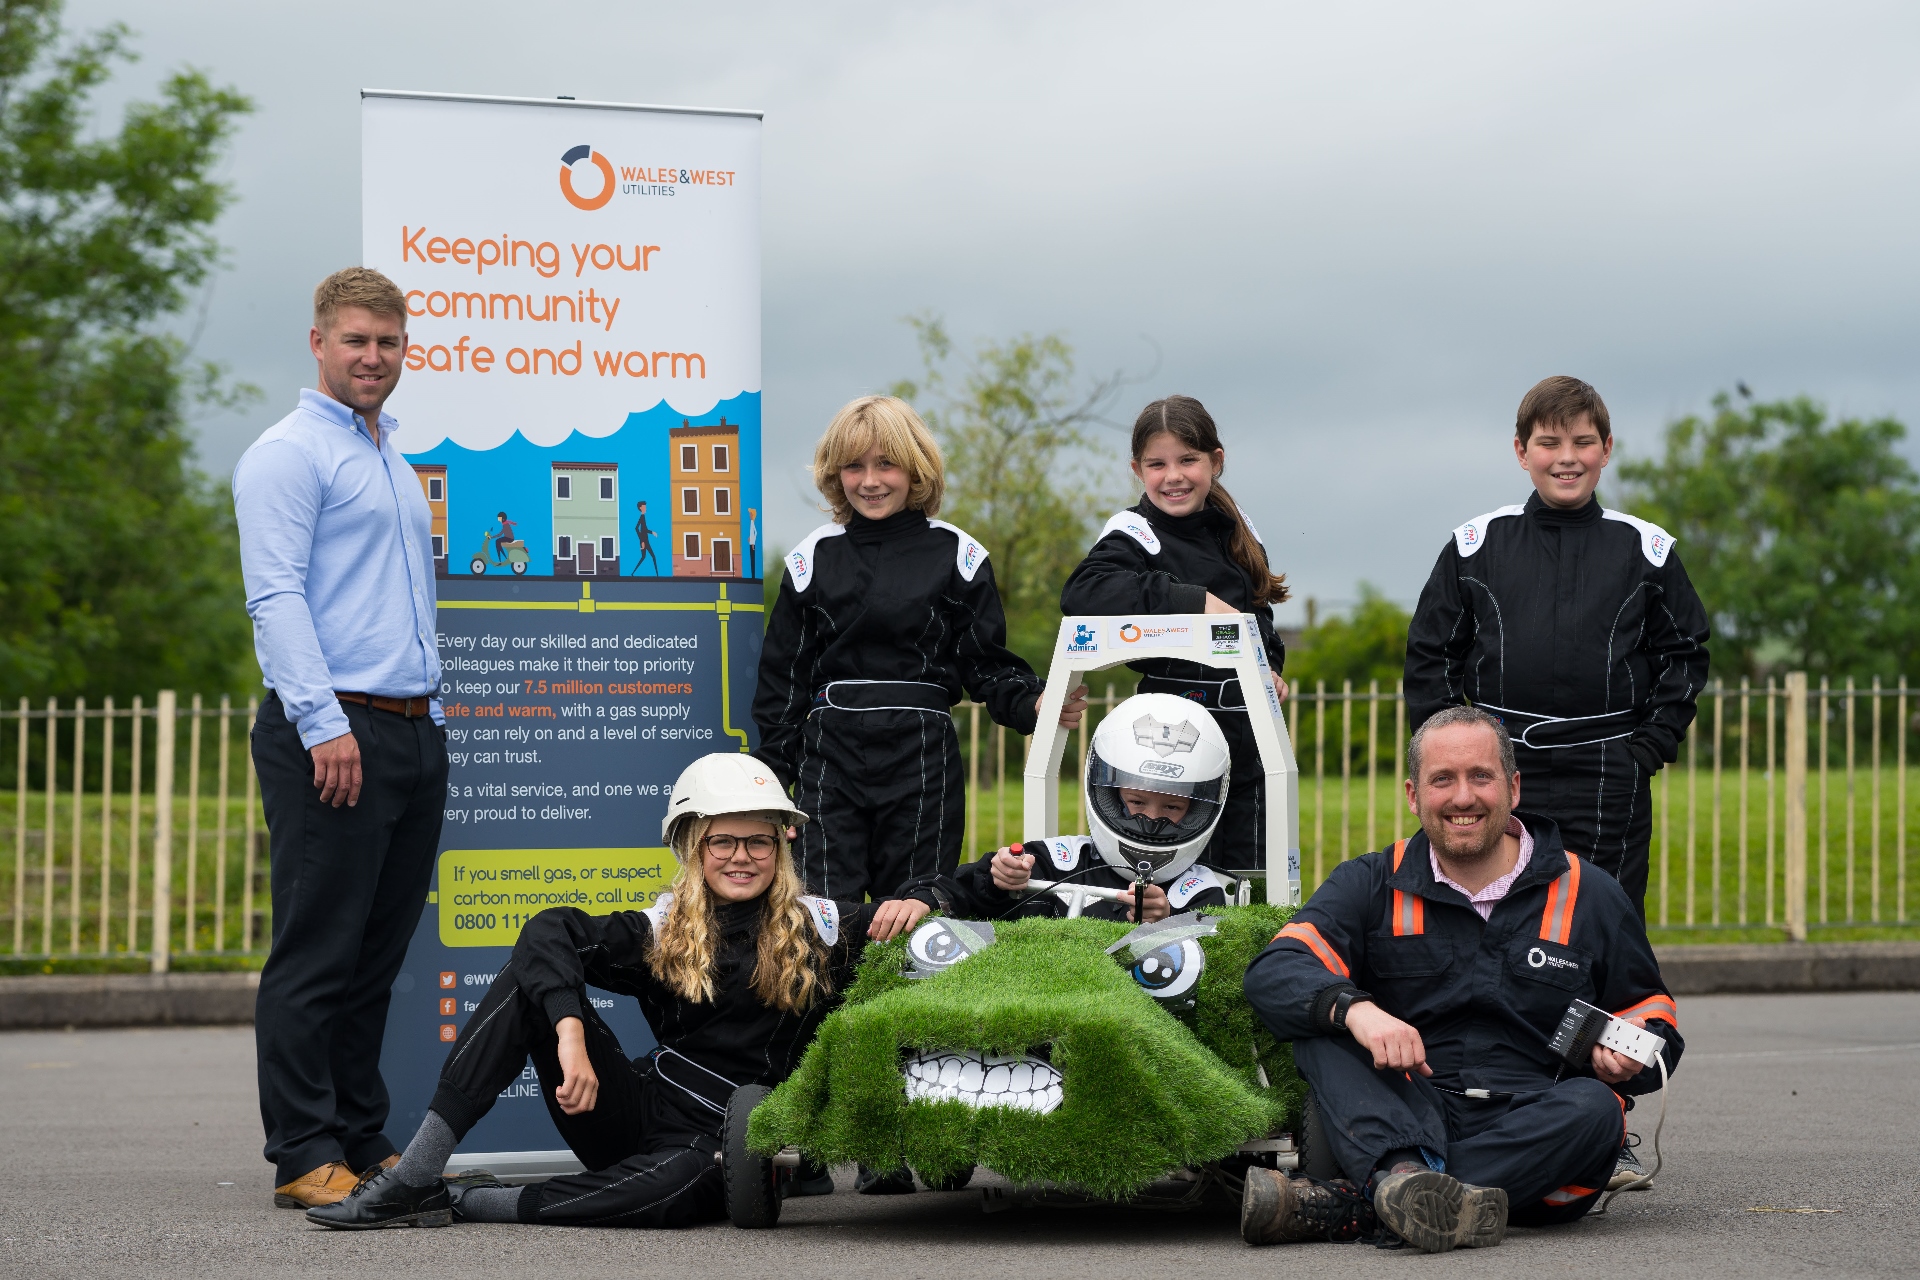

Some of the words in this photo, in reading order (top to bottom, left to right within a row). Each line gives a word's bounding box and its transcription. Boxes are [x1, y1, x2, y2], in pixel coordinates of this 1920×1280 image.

[621, 167, 735, 187] WALES&WEST
[622, 184, 675, 197] UTILITIES
[403, 226, 560, 278] Keeping
[571, 243, 660, 277] your
[405, 288, 620, 333] community
[405, 335, 495, 373] safe
[506, 340, 582, 376] and
[594, 351, 705, 379] warm
[436, 633, 476, 651] Every
[481, 634, 507, 651] day
[512, 637, 536, 648] our
[541, 634, 586, 648] skilled
[592, 635, 618, 648] and
[624, 635, 697, 648] dedicated
[1066, 643, 1098, 652] Admiral
[440, 657, 514, 675] colleagues
[520, 657, 559, 671] make
[564, 657, 572, 671] it
[577, 658, 609, 671] their
[614, 659, 638, 674] top
[644, 658, 694, 674] priority
[441, 683, 451, 694] o
[456, 680, 491, 697] keep
[496, 683, 520, 694] our
[525, 680, 547, 694] 7.5
[552, 680, 603, 694] million
[608, 681, 692, 694] customers
[475, 703, 503, 717] and
[508, 706, 556, 719] warm,
[561, 703, 591, 716] with
[597, 706, 605, 717] a
[610, 706, 636, 720] gas
[641, 705, 690, 720] supply
[474, 729, 499, 740] can
[505, 726, 530, 743] rely
[535, 729, 552, 740] on
[558, 726, 585, 740] and
[590, 729, 599, 739] a
[604, 726, 636, 739] level
[642, 726, 656, 739] of
[661, 726, 712, 739] service
[474, 753, 499, 763] can
[505, 750, 541, 763] trust.
[448, 783, 460, 797] 's
[464, 786, 473, 797] a
[477, 783, 506, 796] vital
[511, 783, 566, 798] service,
[572, 782, 599, 796] and
[605, 785, 632, 796] one
[637, 785, 658, 795] we
[475, 806, 516, 823] proud
[521, 806, 536, 819] to
[541, 805, 591, 819] deliver.
[454, 866, 465, 881] If
[470, 870, 496, 884] you
[500, 865, 540, 880] smell
[544, 869, 576, 884] gas,
[580, 868, 597, 879] or
[602, 864, 662, 882] suspect
[454, 890, 510, 905] carbon
[514, 889, 592, 907] monoxide,
[596, 888, 622, 903] call
[627, 892, 645, 902] us
[648, 891, 662, 902] o
[454, 914, 496, 930] 0800
[588, 997, 614, 1008] ities
